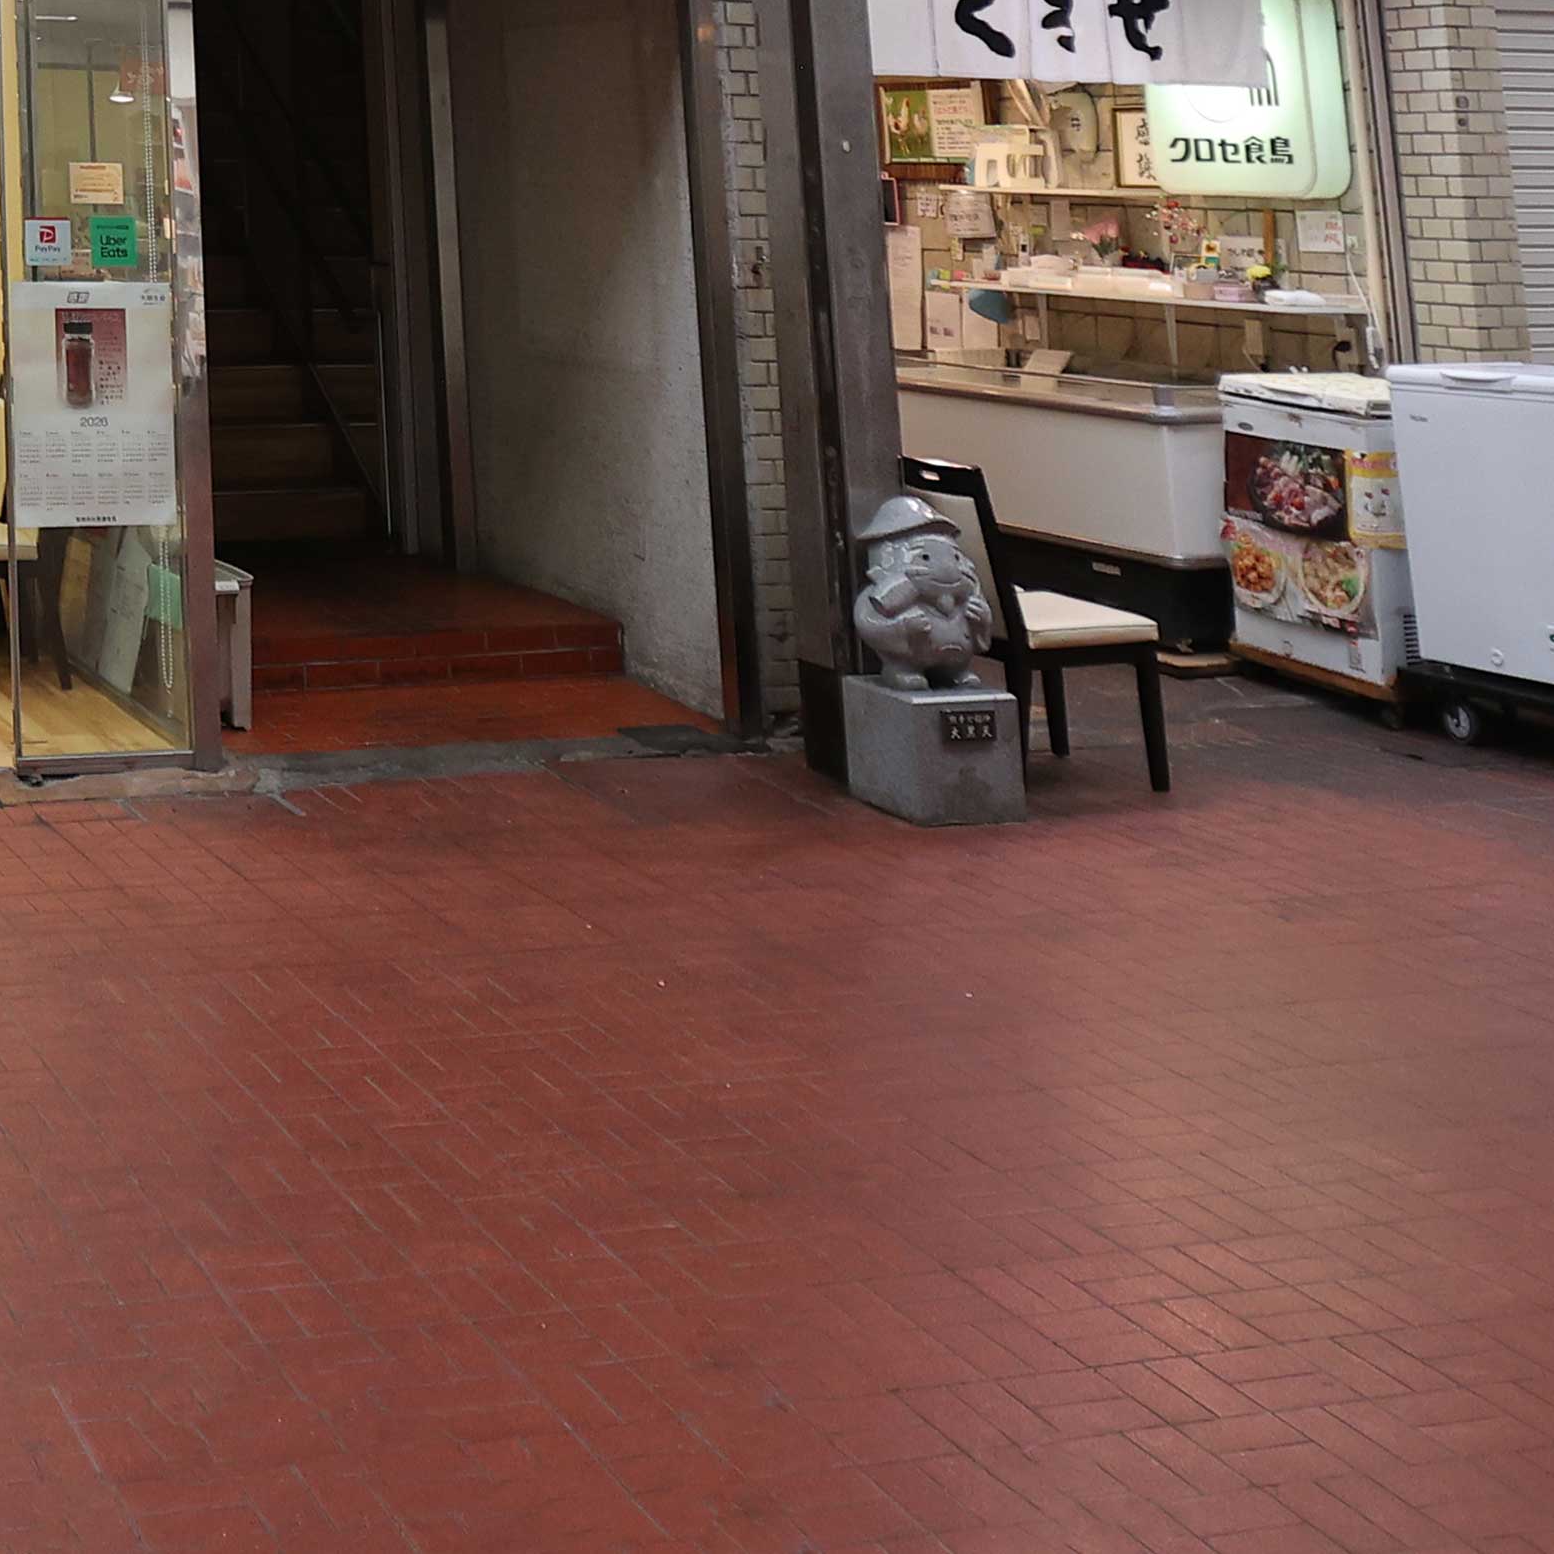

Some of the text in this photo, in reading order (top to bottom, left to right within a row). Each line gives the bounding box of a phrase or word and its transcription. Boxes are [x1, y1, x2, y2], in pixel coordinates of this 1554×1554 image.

[1169, 135, 1294, 164] クロセ食鳥
[100, 236, 127, 246] Uber
[101, 247, 128, 258] Eats
